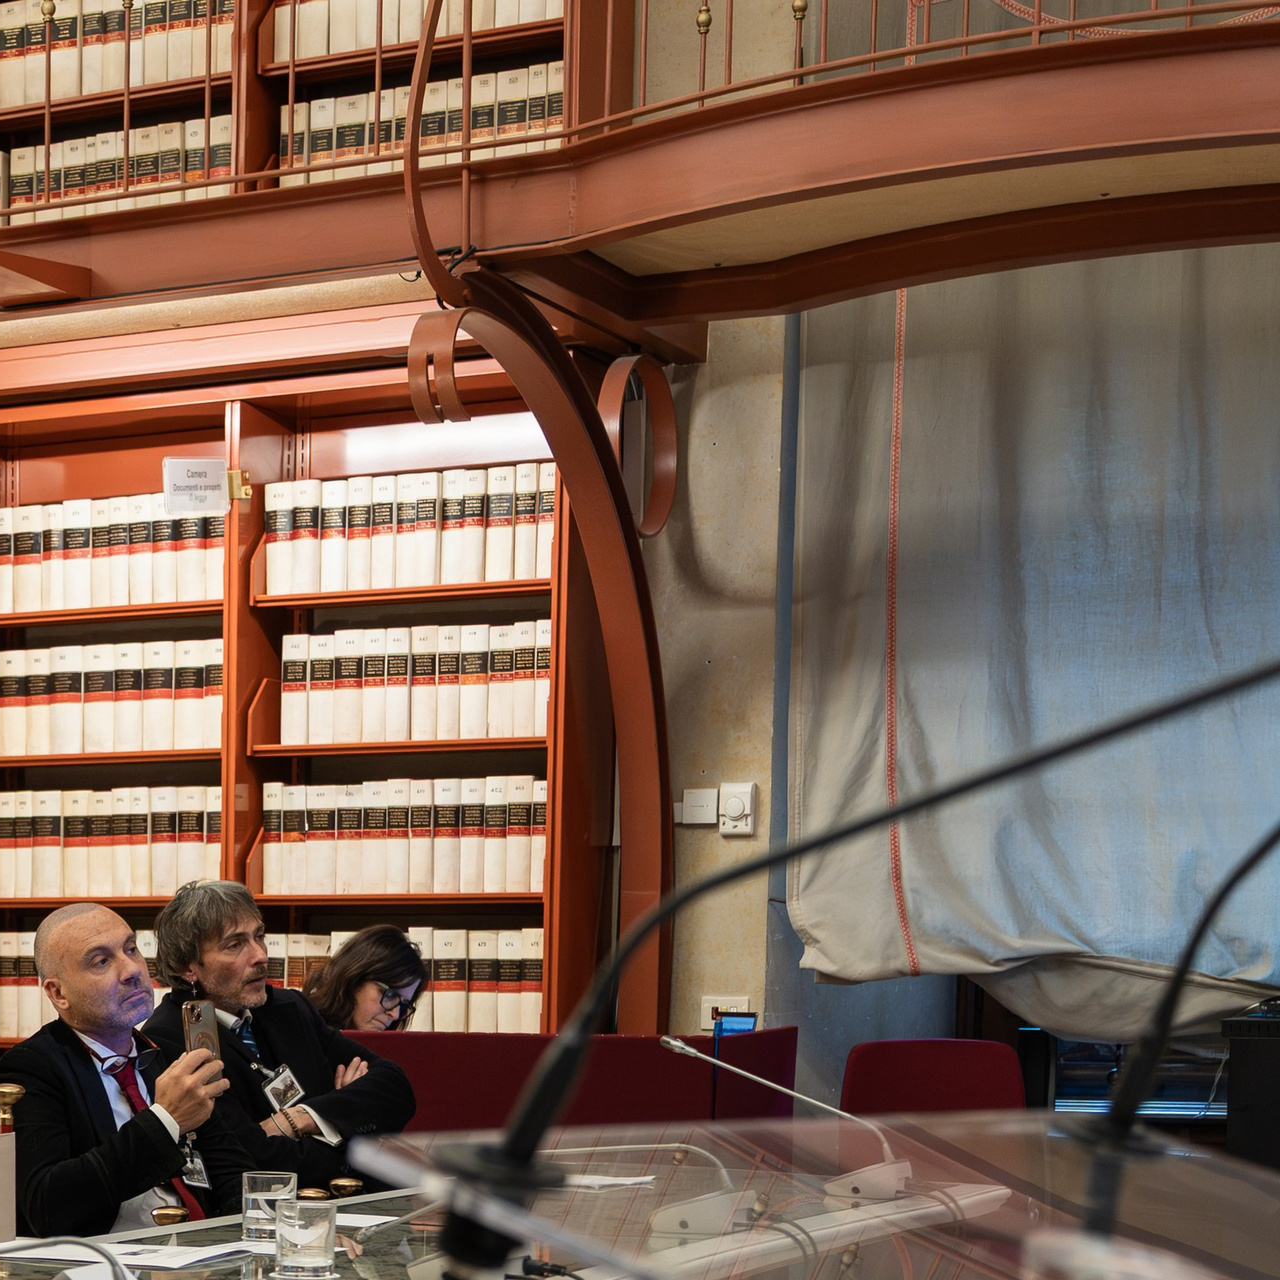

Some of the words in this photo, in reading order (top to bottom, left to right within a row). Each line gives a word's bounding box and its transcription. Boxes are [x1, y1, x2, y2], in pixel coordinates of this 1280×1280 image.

[186, 469, 208, 479] Camera
[173, 483, 199, 492] Documenti
[204, 484, 222, 493] progetti
